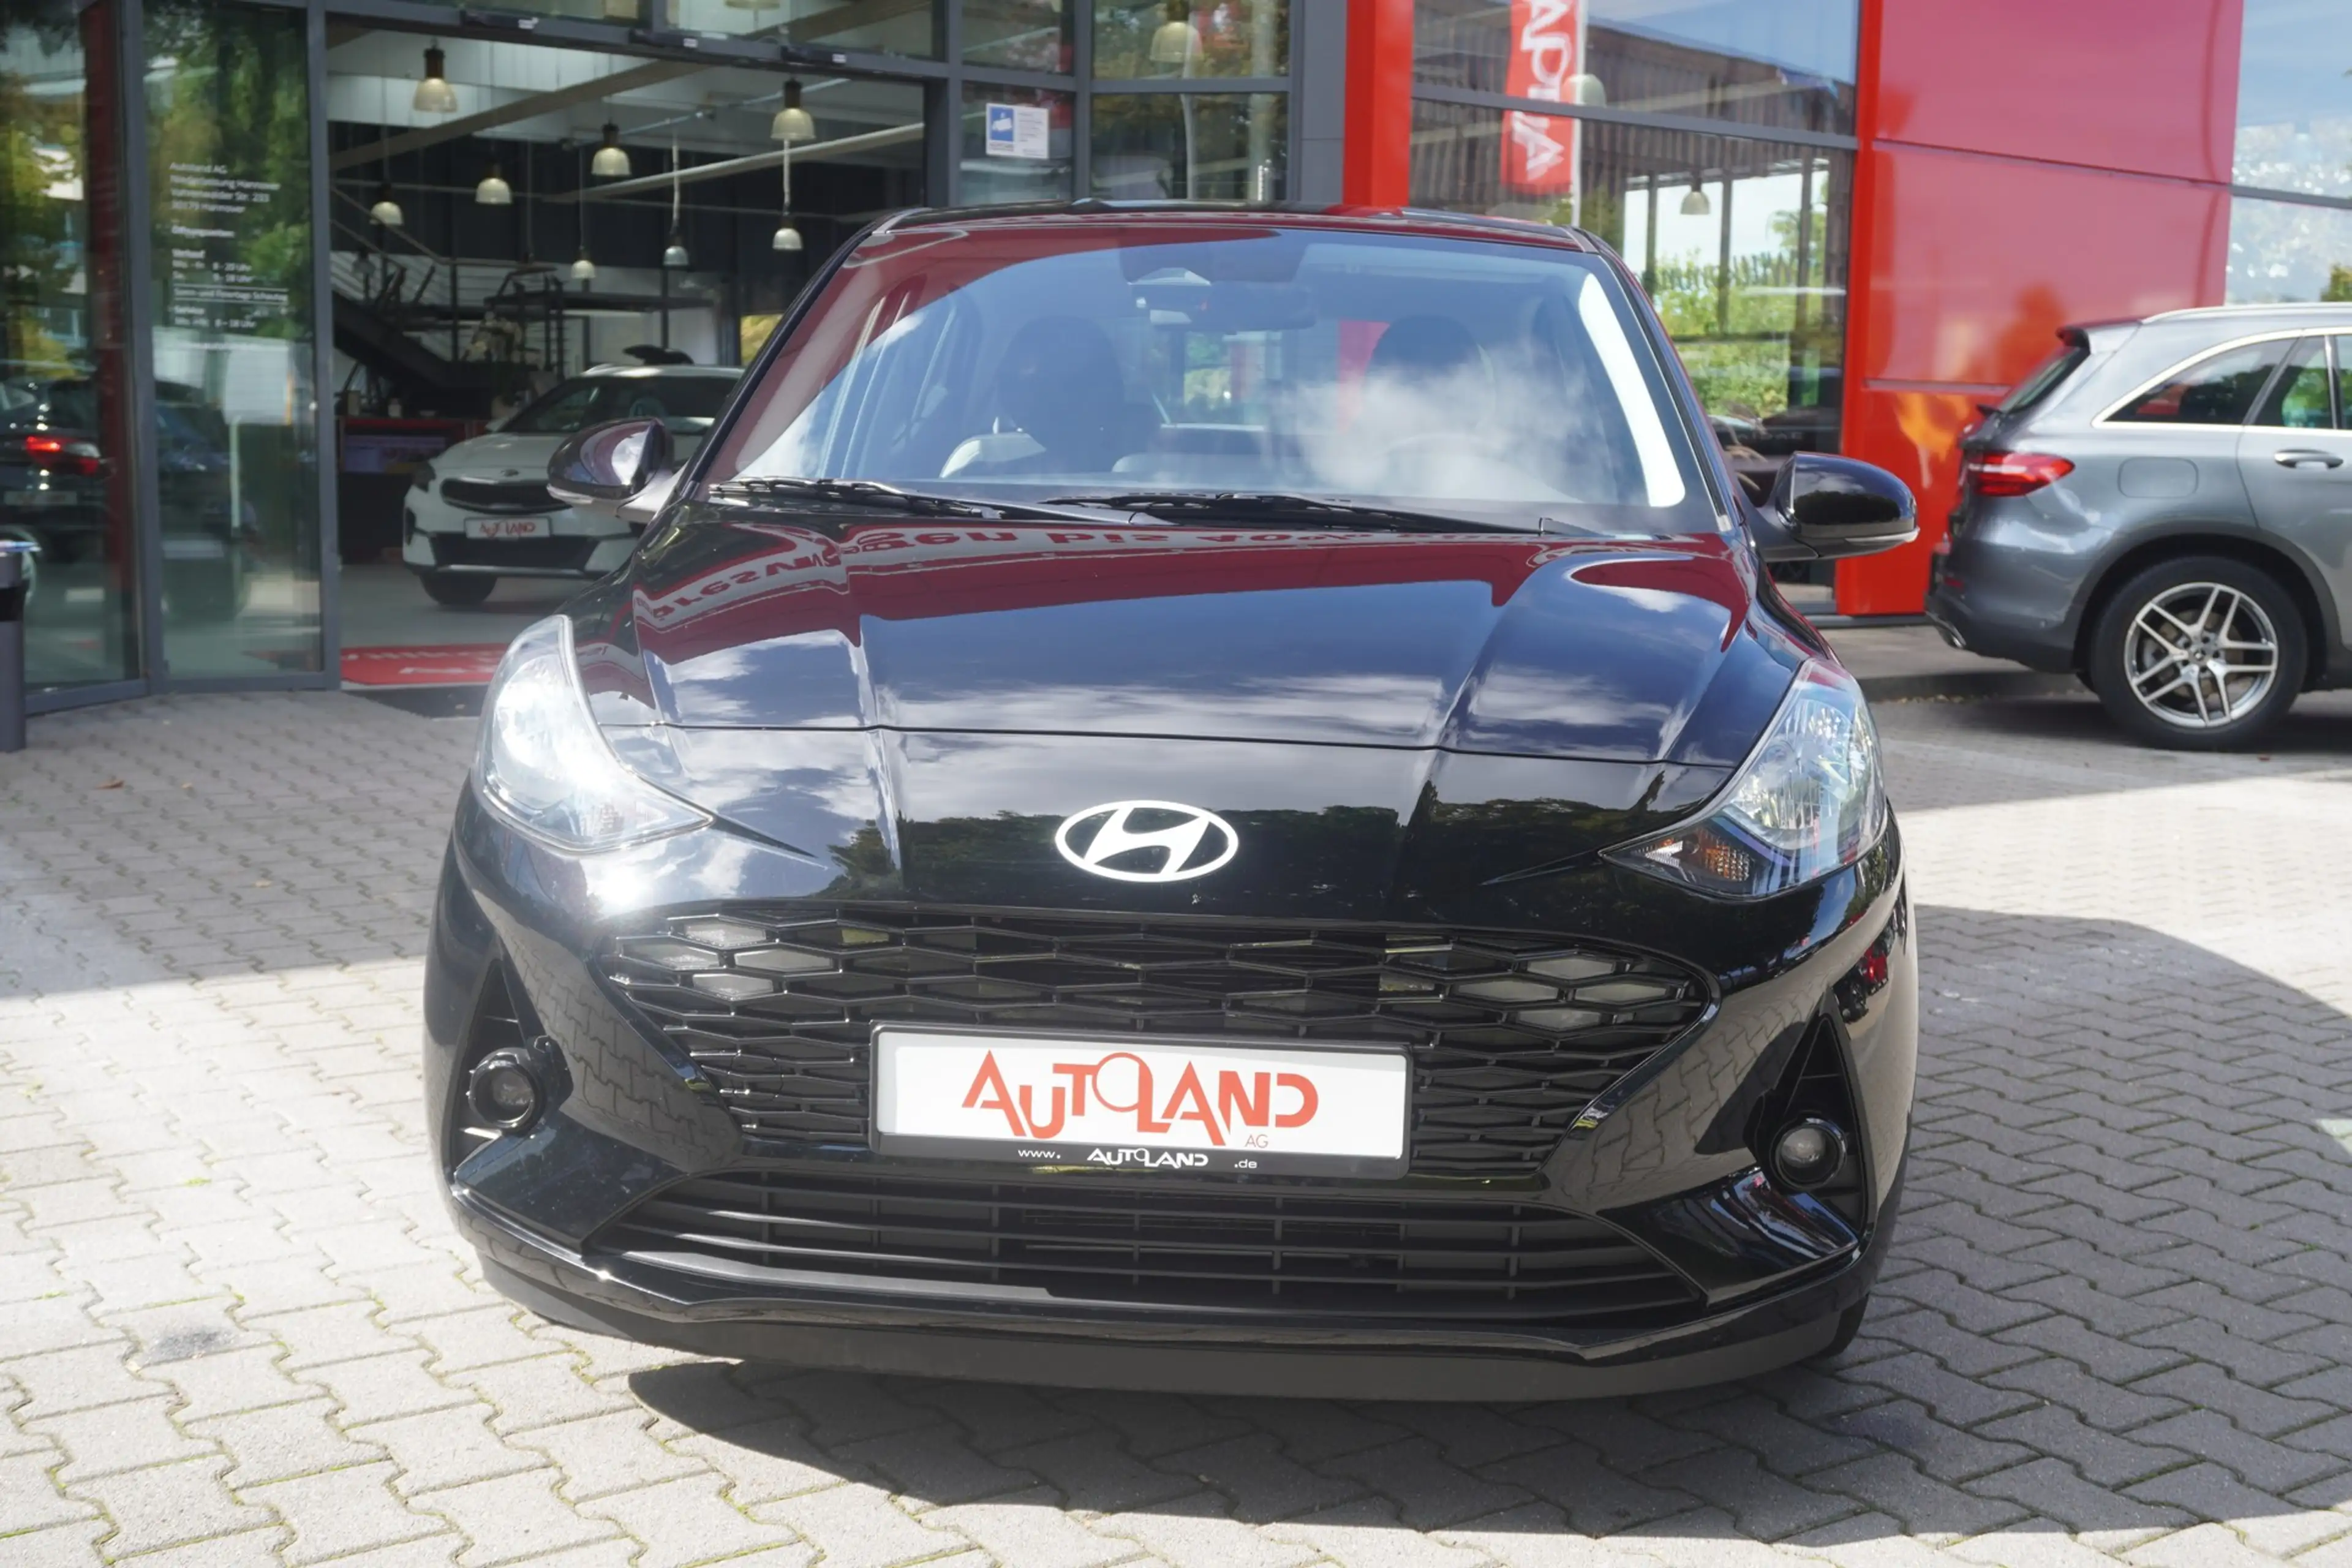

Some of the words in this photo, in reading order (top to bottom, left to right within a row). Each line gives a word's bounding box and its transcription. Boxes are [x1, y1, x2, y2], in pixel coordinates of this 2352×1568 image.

[1245, 1134, 1268, 1149] AG
[1018, 1148, 1061, 1159] www.
[1087, 1147, 1209, 1169] AUTOLAND
[1234, 1158, 1258, 1169] .de
